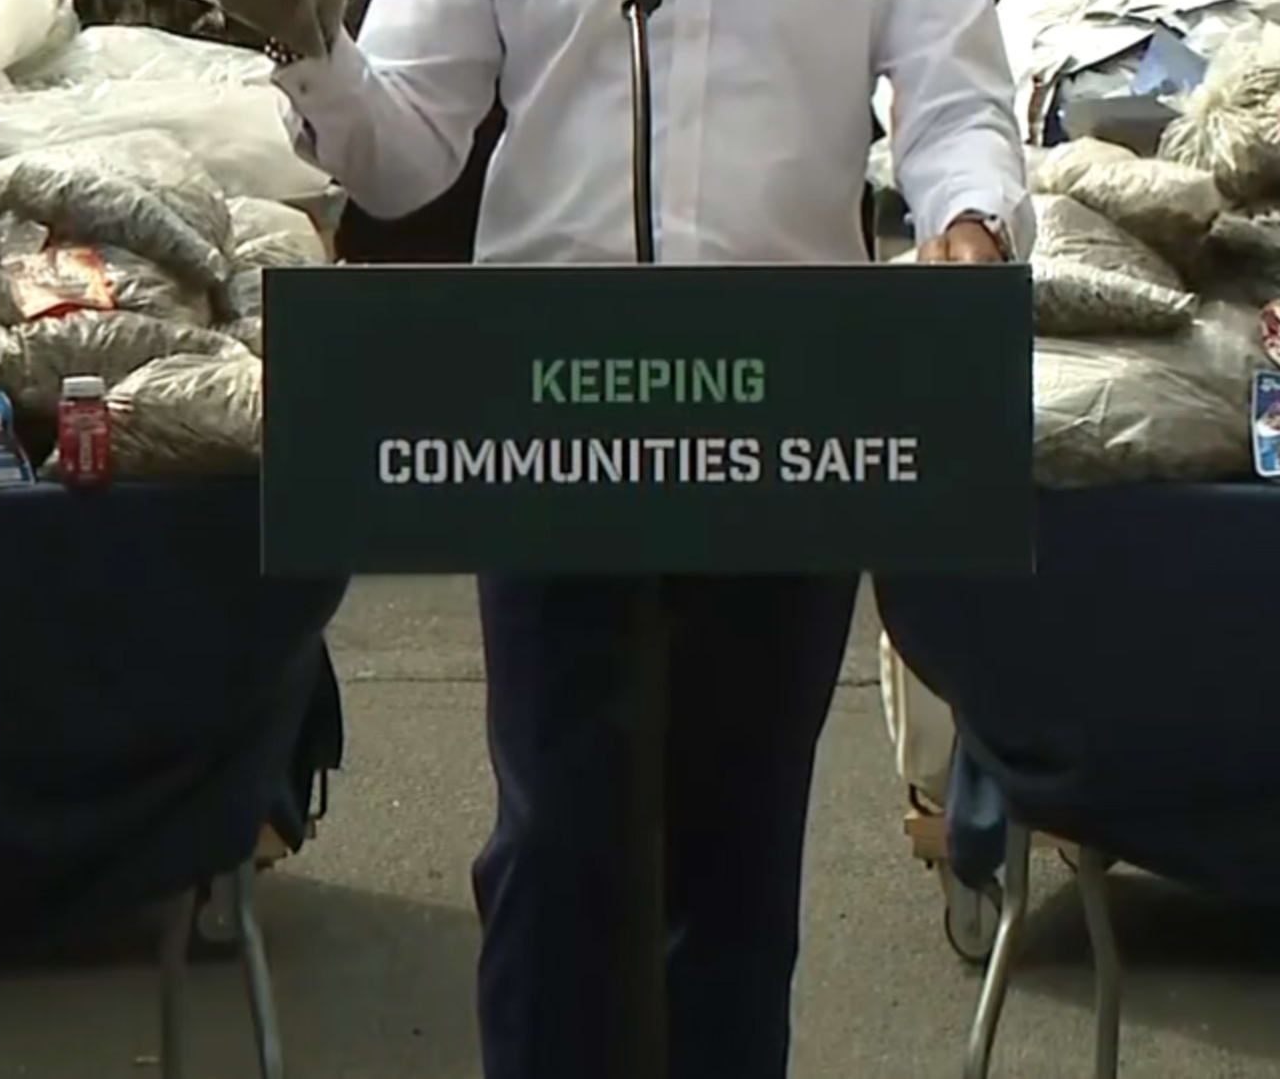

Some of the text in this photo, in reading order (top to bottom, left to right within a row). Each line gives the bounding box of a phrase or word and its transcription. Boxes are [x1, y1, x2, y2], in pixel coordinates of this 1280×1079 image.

[532, 358, 764, 403] KEEPING
[379, 437, 918, 484] COMMUNITIES SAFE
